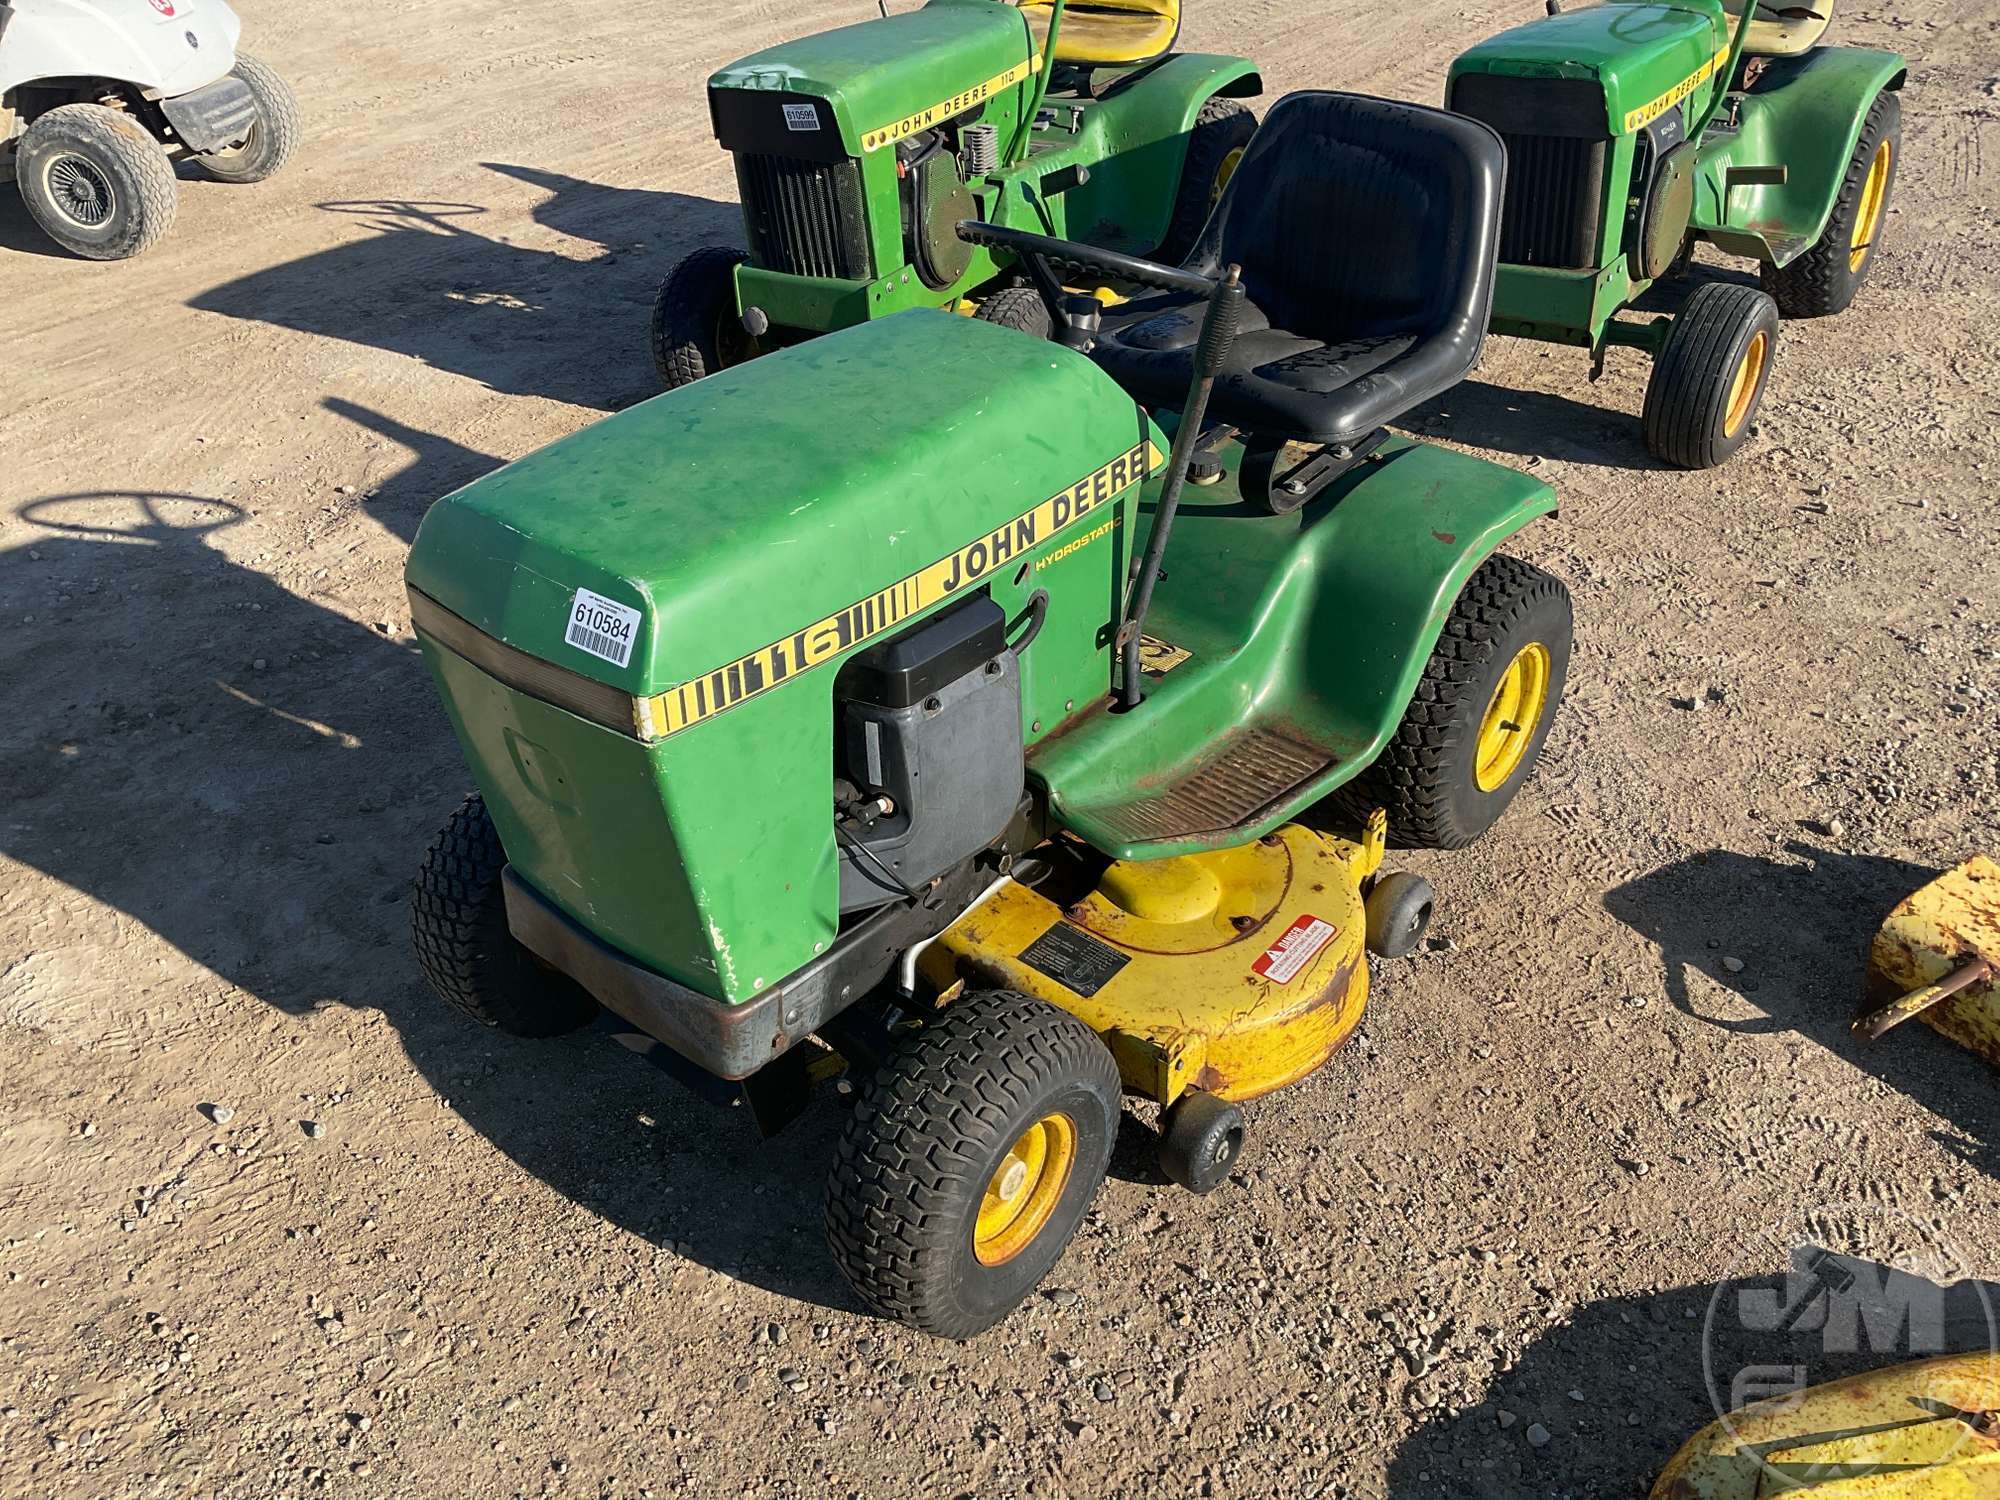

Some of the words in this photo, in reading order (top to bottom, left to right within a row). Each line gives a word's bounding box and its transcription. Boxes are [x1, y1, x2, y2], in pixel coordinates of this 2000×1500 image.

[786, 110, 815, 120] 610599
[892, 110, 932, 138] JOHN
[944, 84, 987, 115] DEERE
[1001, 71, 1015, 85] 110
[1646, 95, 1670, 120] JOHN
[1675, 71, 1701, 99] DEERE
[750, 618, 841, 681] 116
[943, 512, 1036, 592] JOHN
[1053, 447, 1145, 530] DEERE
[1034, 516, 1123, 572] HYDROSTATIC
[575, 603, 631, 643] 610584
[1278, 926, 1305, 949] DANGER
